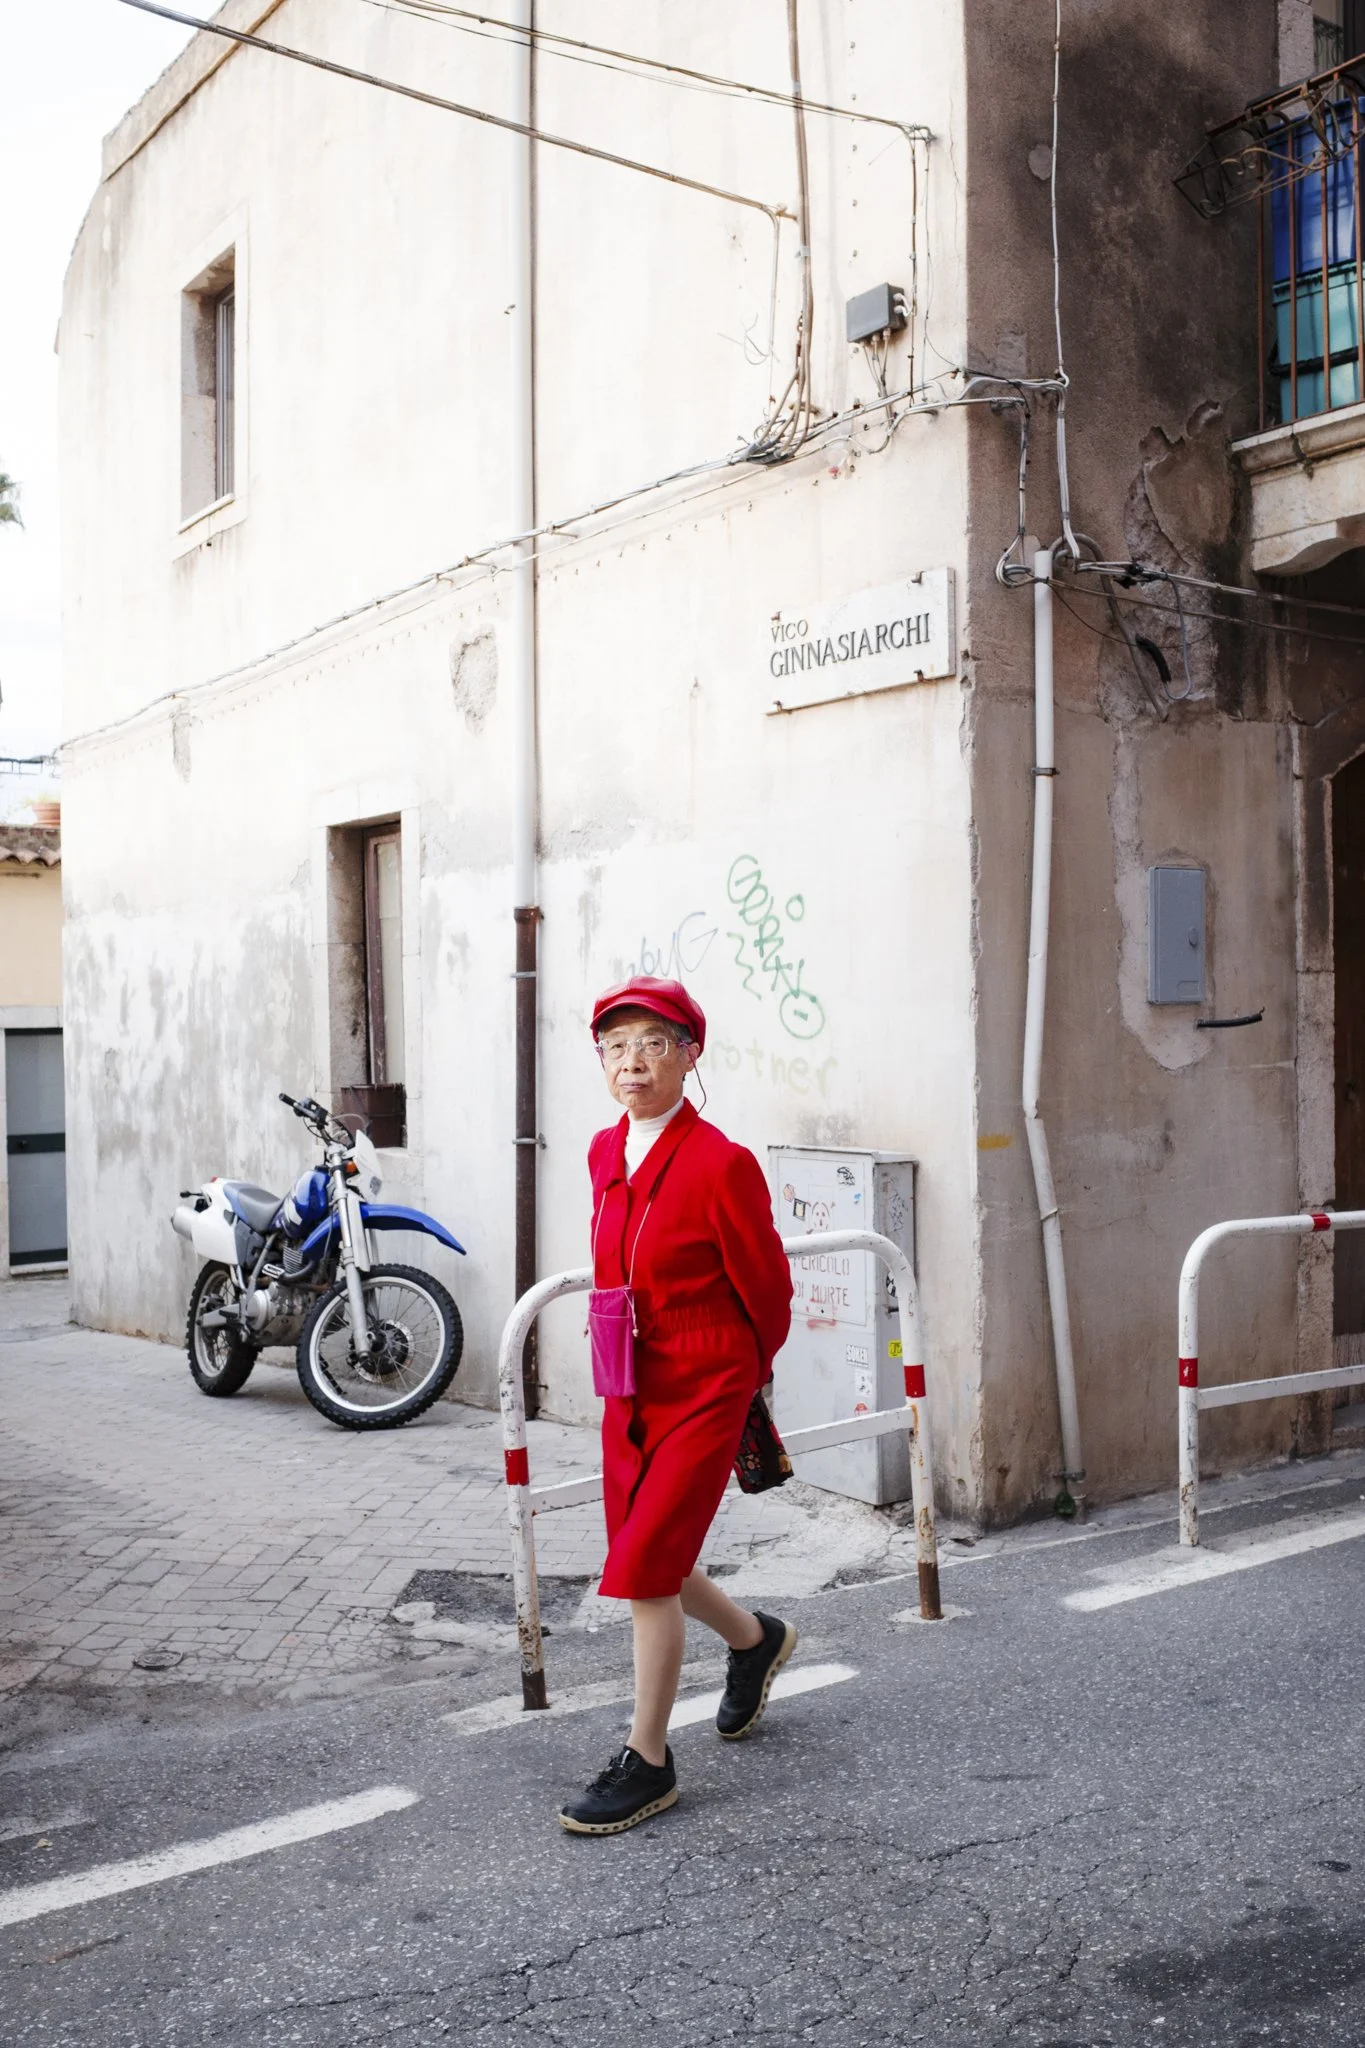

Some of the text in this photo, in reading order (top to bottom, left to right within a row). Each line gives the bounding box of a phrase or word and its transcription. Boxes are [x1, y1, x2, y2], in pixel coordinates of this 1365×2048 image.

[770, 619, 809, 644] VICO
[770, 613, 931, 678] GINNASIARCHI
[811, 1282, 851, 1307] MORTE
